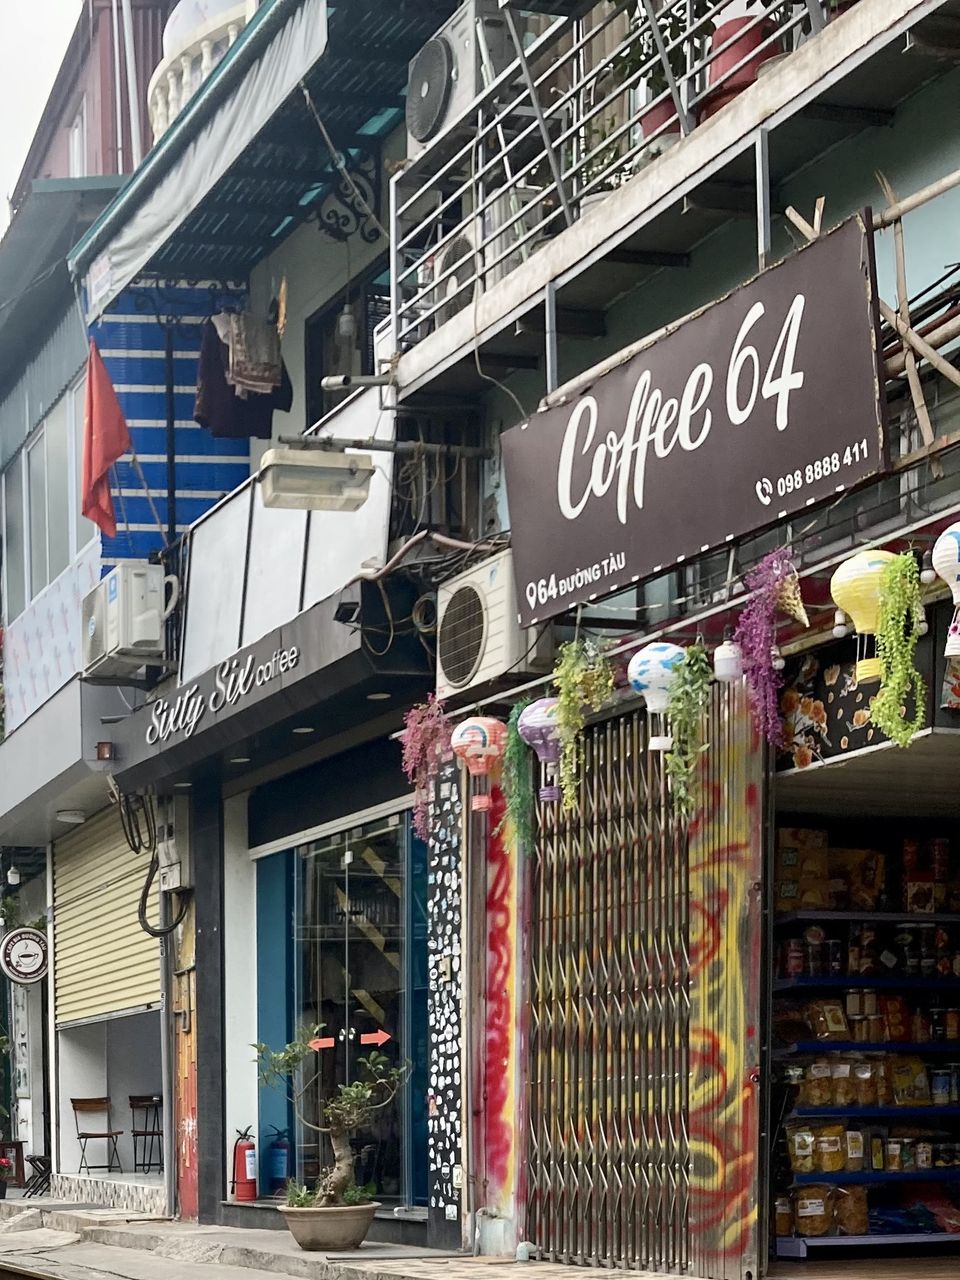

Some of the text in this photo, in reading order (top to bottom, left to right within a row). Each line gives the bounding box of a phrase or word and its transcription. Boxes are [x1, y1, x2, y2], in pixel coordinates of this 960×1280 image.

[557, 293, 806, 525] Coffee 64
[777, 438, 868, 497] 098 8888 411
[537, 551, 626, 605] 64 ĐƯỜNG TÀU
[145, 646, 300, 745] Sixty Six coffee
